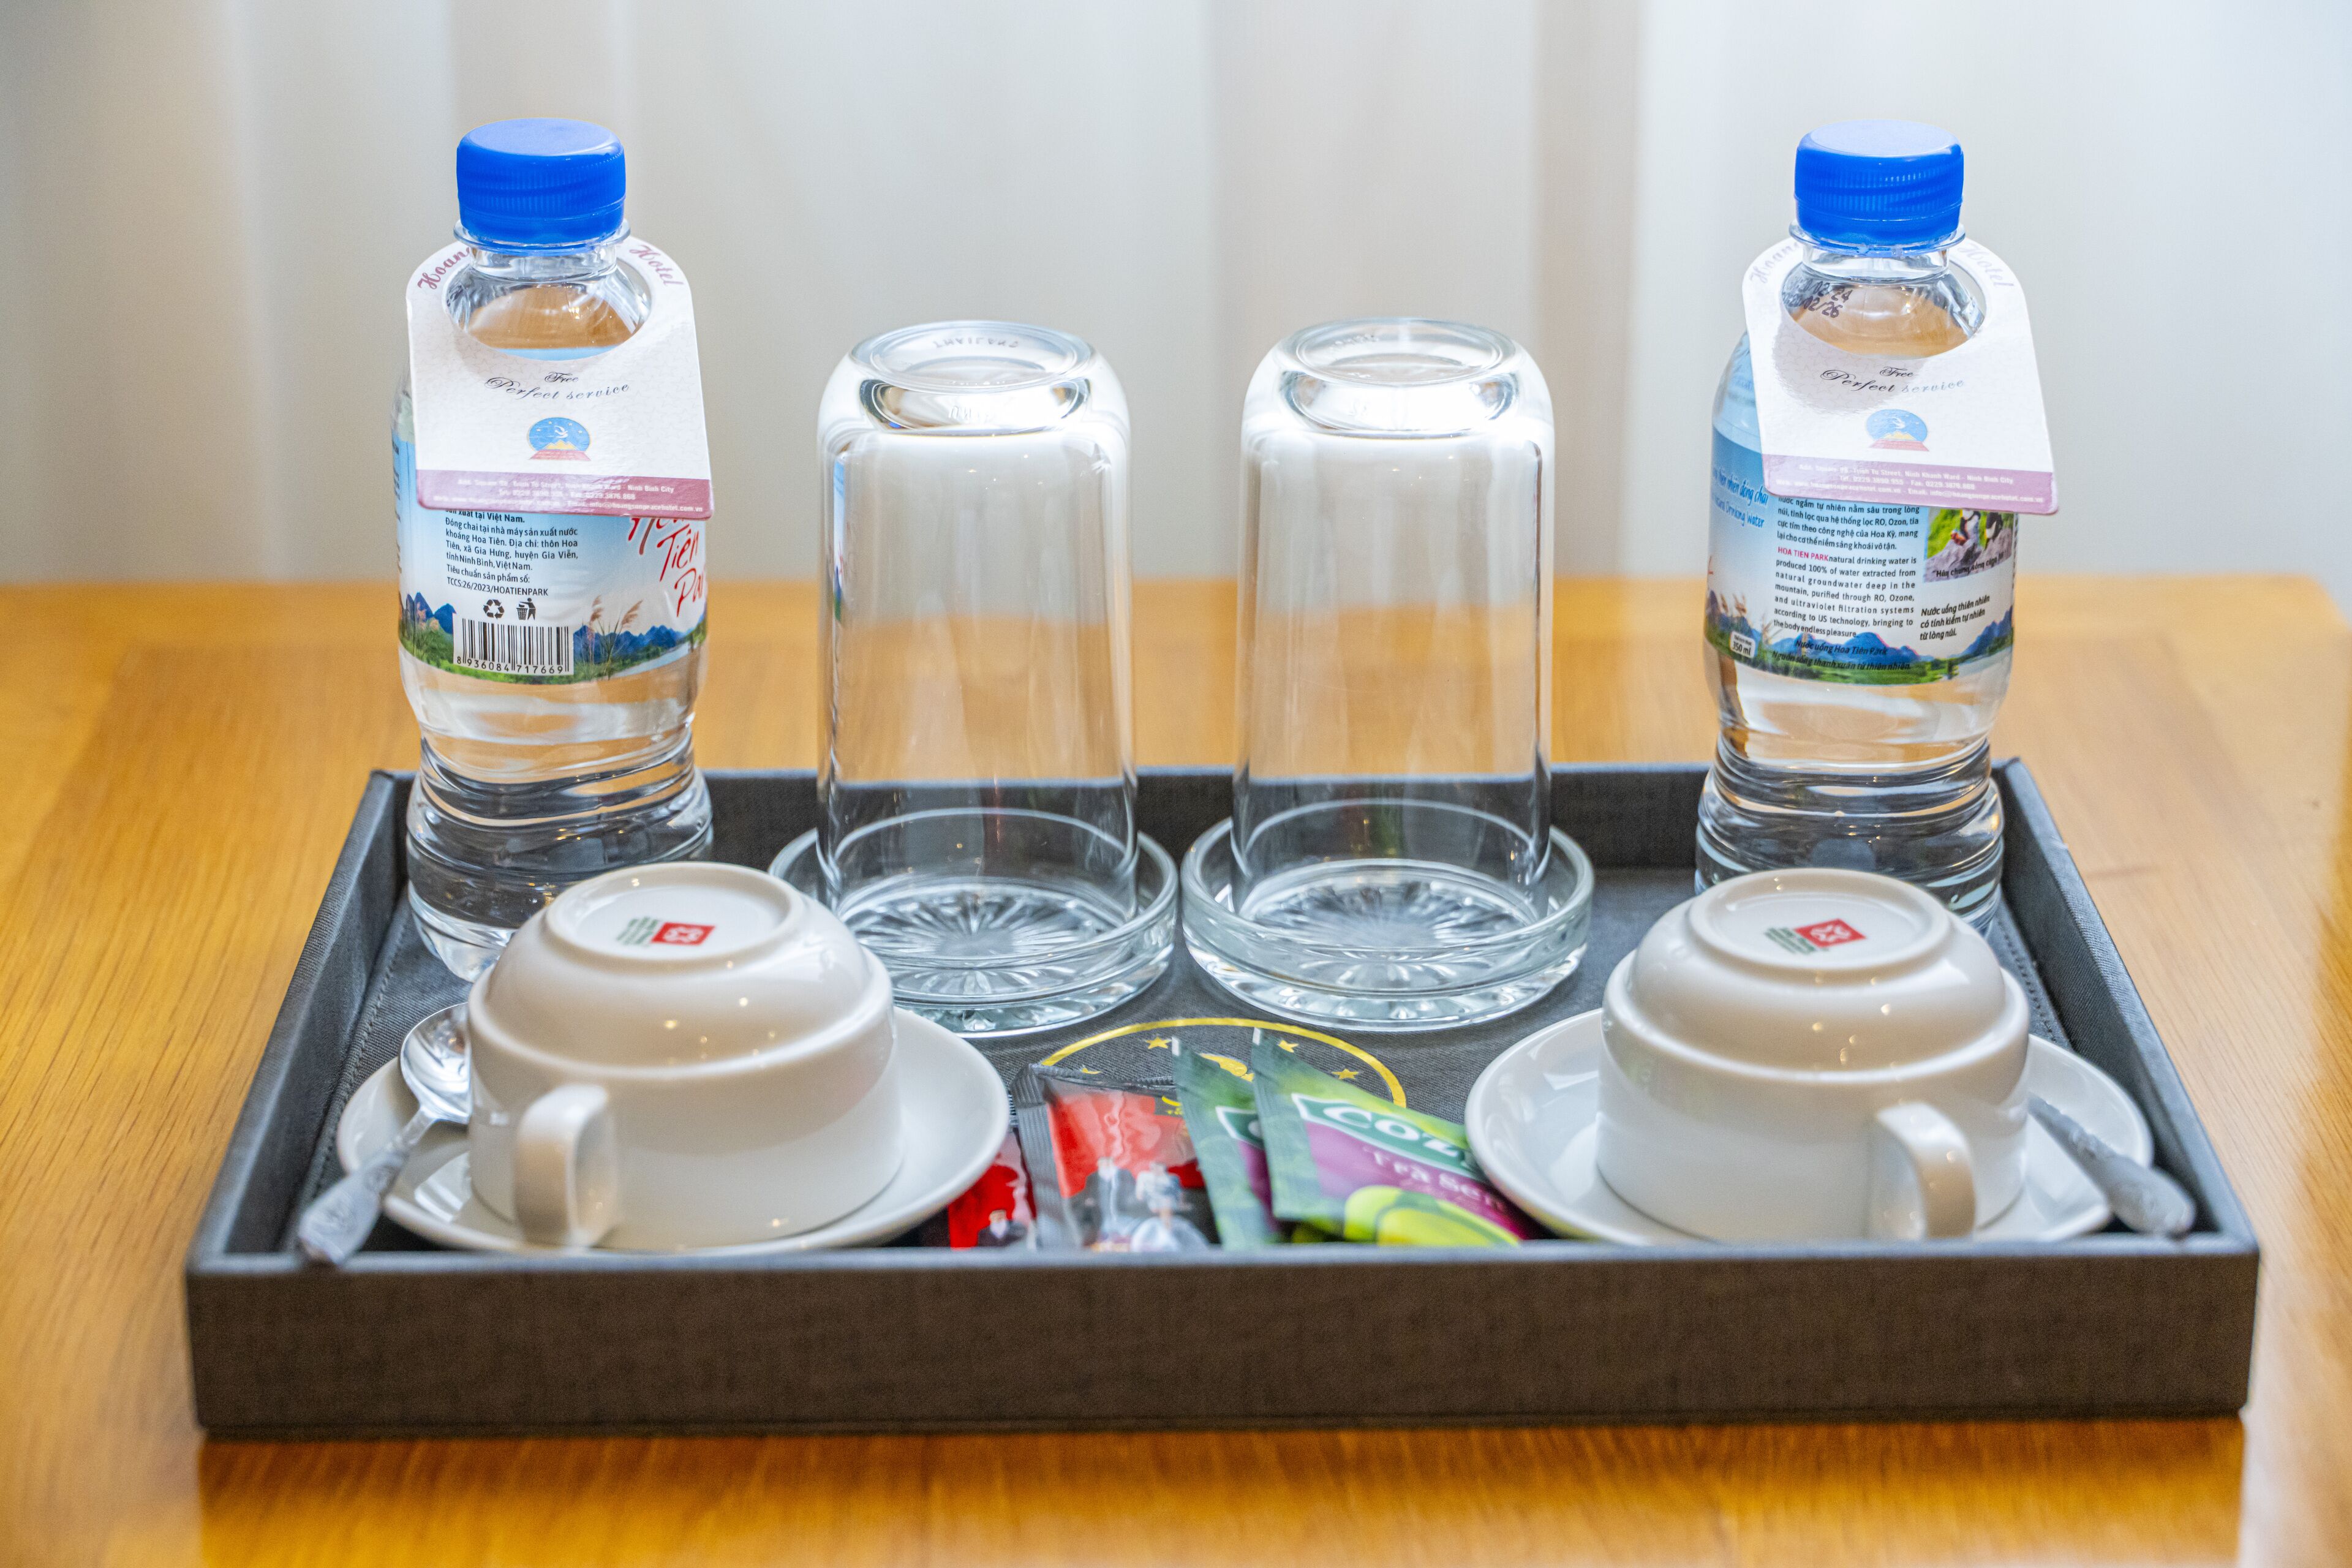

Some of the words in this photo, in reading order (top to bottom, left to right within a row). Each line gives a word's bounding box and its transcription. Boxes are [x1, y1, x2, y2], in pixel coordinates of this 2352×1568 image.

[629, 245, 684, 287] Hotel
[545, 372, 579, 383] Free
[1820, 369, 1895, 393] Perfect
[1902, 380, 1964, 393] service
[1880, 366, 1914, 377] Free
[484, 377, 560, 399] Perfect
[567, 383, 629, 399] service
[1777, 508, 1789, 517] núi,
[1804, 512, 1815, 521] lọc
[1831, 514, 1839, 524] hệ
[1841, 516, 1861, 527] thống
[1863, 518, 1873, 527] lọc
[1826, 502, 1846, 512] nhiên
[1849, 504, 1864, 513] nằm
[1904, 505, 1920, 515] lòng
[445, 517, 462, 529] Đóng
[464, 522, 478, 531] chai
[491, 526, 505, 535] nhà
[507, 528, 523, 537] máy
[540, 527, 557, 536] xuất
[505, 514, 525, 523] Nam.
[1777, 519, 1788, 529] cực
[1789, 521, 1800, 530] tím
[1802, 524, 1817, 533] theo
[1819, 526, 1835, 537] công
[1836, 527, 1854, 538] nghệ
[1786, 533, 1797, 542] cho
[446, 529, 470, 543] khoáng
[472, 535, 486, 543] Hoa
[489, 537, 507, 546] Tiên.
[509, 539, 522, 548] Địa
[446, 540, 461, 551] Tiên,
[474, 546, 486, 555] Gia
[489, 548, 511, 560] Hưng,
[514, 550, 538, 560] huyện
[558, 549, 578, 560] Viễn,
[657, 524, 699, 582] Tiên
[1777, 547, 1792, 556] HOA
[1794, 550, 1809, 559] TIEN
[1857, 557, 1887, 567] drinking
[447, 564, 460, 574] Tiêu
[461, 568, 481, 578] chuẩn
[483, 571, 496, 580] sản
[497, 572, 518, 582] phẩm
[519, 573, 530, 583] số:
[459, 556, 475, 565] Ninh
[477, 558, 495, 569] Bình,
[496, 560, 511, 572] Việt
[1776, 559, 1806, 571] produced
[1809, 565, 1827, 573] 100%
[447, 576, 548, 596] TCCS:26/2023/HOATIENPARK
[1776, 571, 1805, 582] natural
[1807, 578, 1862, 589] groundwater
[1866, 582, 1887, 591] deep
[1775, 583, 1809, 596] mountain,
[1811, 590, 1839, 600] purified
[1842, 593, 1871, 603] through
[1874, 594, 1887, 603] RO,
[1774, 595, 1788, 605] and
[1791, 598, 1835, 611] ultraviolet
[1838, 605, 1877, 614] filtration
[1880, 606, 1913, 616] systems
[1921, 606, 1940, 616] Nước
[1942, 603, 1957, 614] uống
[1958, 600, 1974, 611] thiên
[1975, 595, 1990, 605] nhiên
[1774, 608, 1806, 621] according
[1830, 616, 1870, 627] technology,
[1872, 619, 1904, 627] bringing
[1774, 619, 1784, 628] the
[1784, 621, 1800, 632] body
[1801, 624, 1825, 635] endless
[1920, 619, 1929, 628] có
[1931, 618, 1945, 627] tính
[1962, 614, 1969, 623] tự
[1969, 609, 1985, 619] nhiên
[1929, 630, 1944, 640] lòng
[1834, 645, 1850, 654] Hoa
[1869, 647, 1888, 655] Park
[1323, 1106, 1471, 1167] COZ
